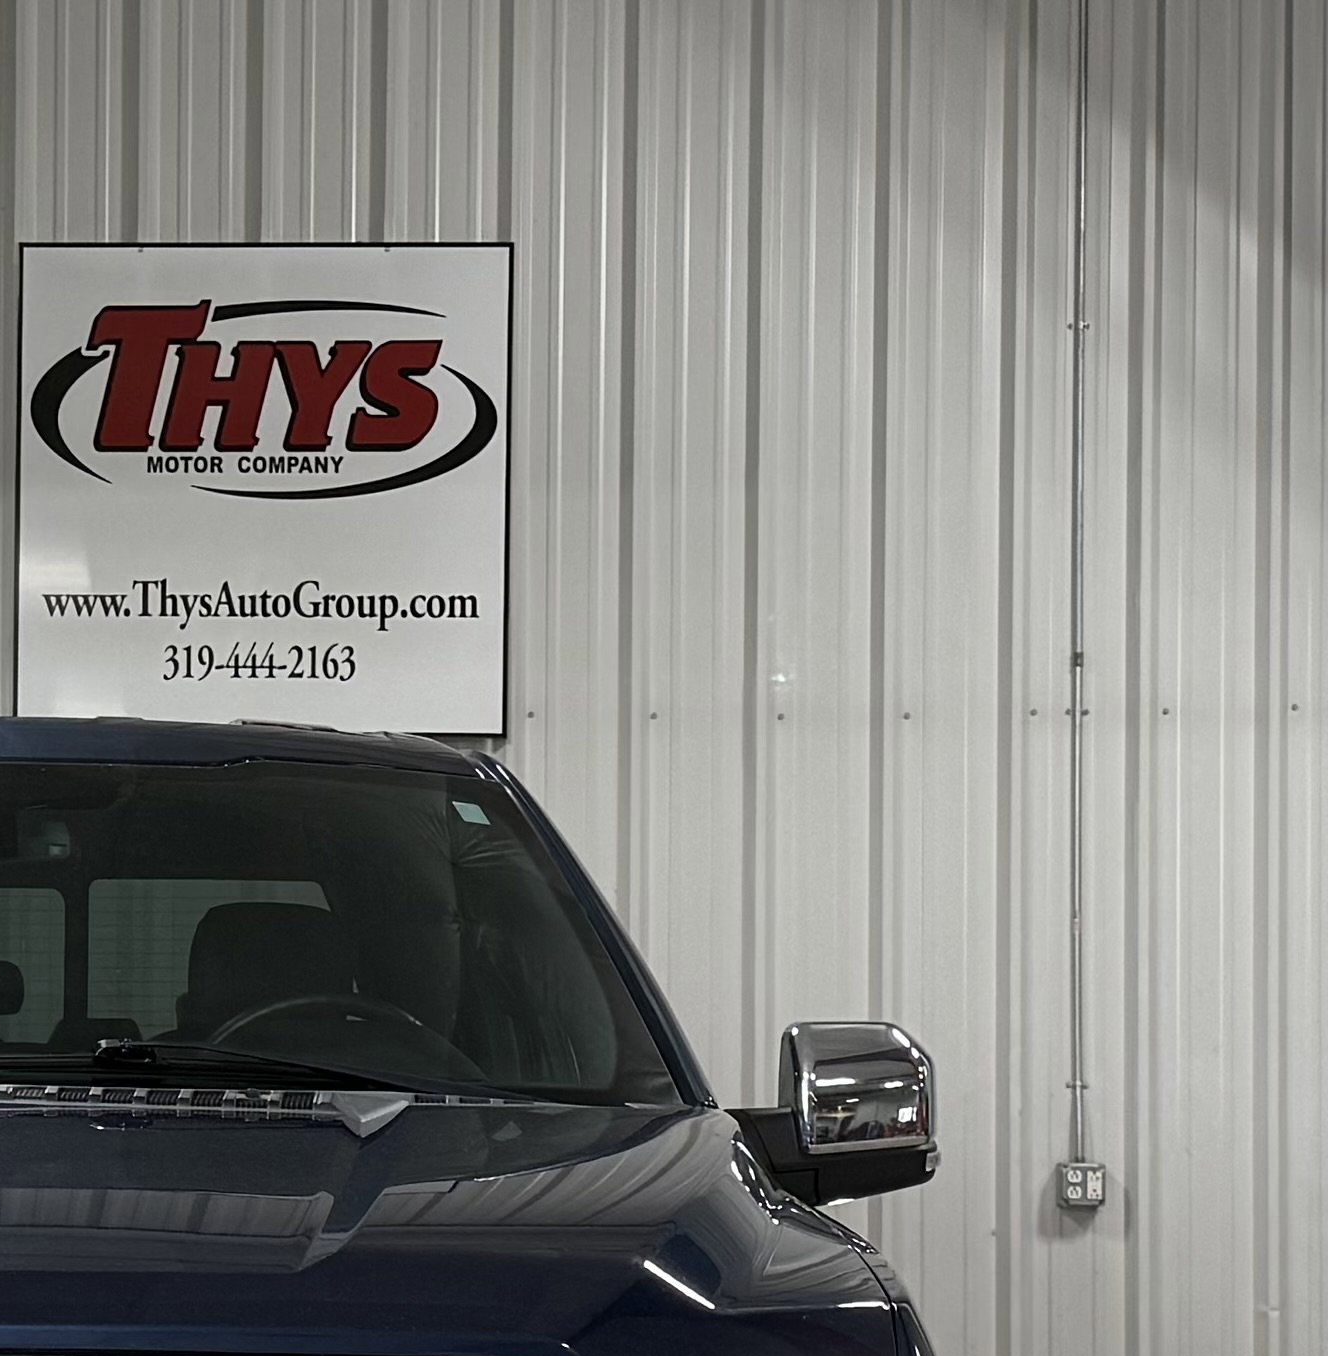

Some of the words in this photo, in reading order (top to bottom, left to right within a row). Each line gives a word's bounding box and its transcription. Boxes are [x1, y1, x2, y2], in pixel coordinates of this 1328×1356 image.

[87, 299, 443, 452] THYS
[146, 456, 224, 474] MOTOR
[237, 456, 344, 474] COMPANY
[42, 578, 480, 631] www.ThysAutoGroup.com
[162, 642, 356, 681] 319-444-2163
